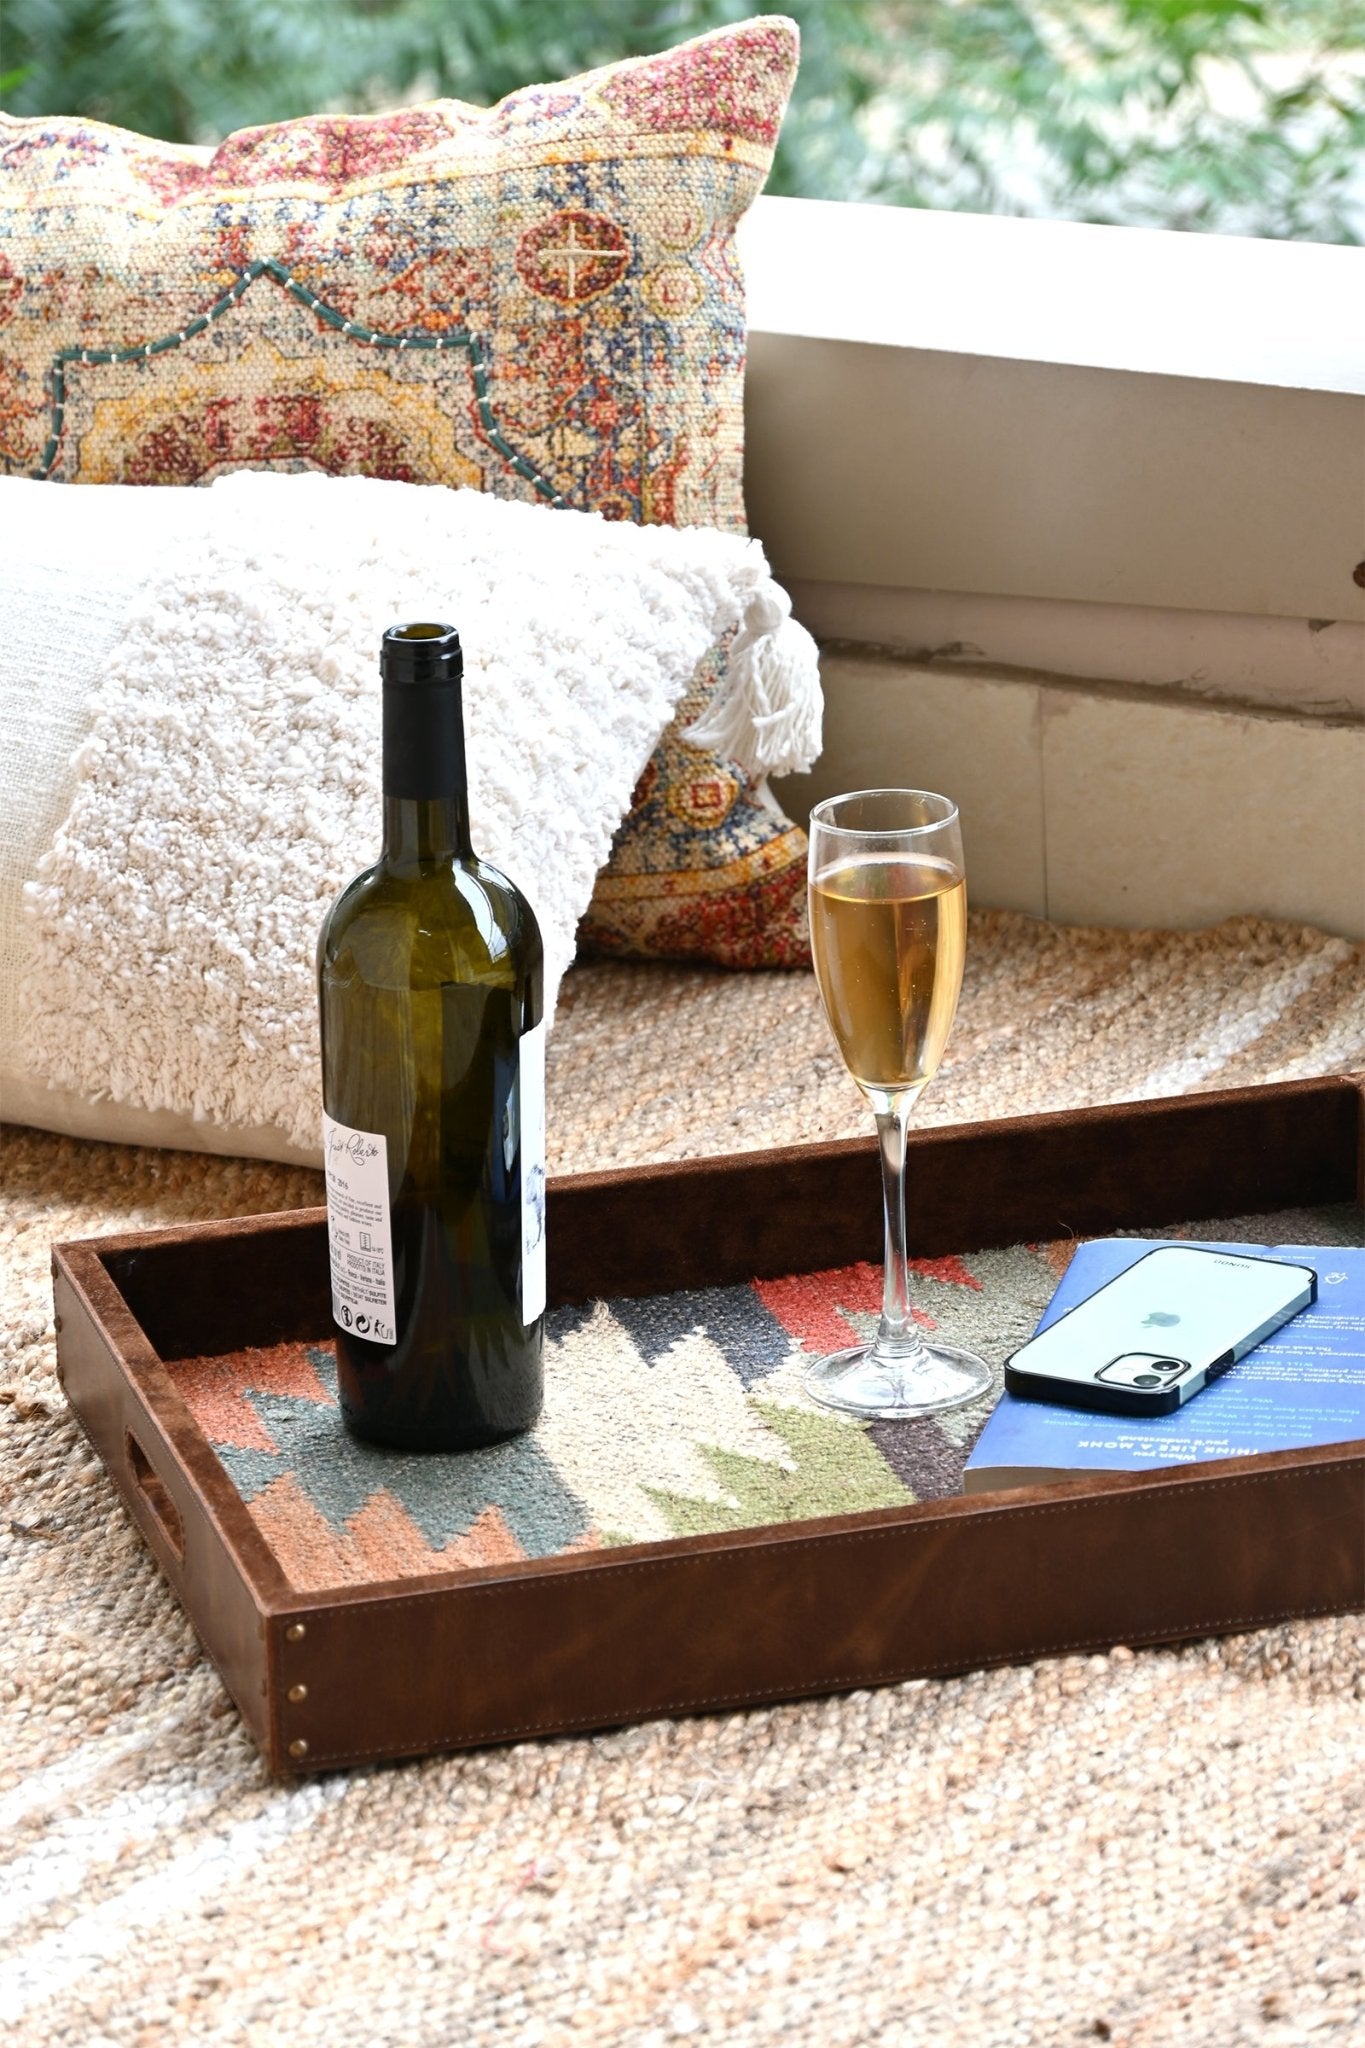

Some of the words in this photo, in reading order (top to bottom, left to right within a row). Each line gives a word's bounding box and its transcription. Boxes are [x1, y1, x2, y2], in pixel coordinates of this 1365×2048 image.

[1077, 1441, 1134, 1449] MONK
[1158, 1445, 1198, 1453] LIKE
[1204, 1446, 1259, 1455] THINK
[1159, 1453, 1197, 1461] When
